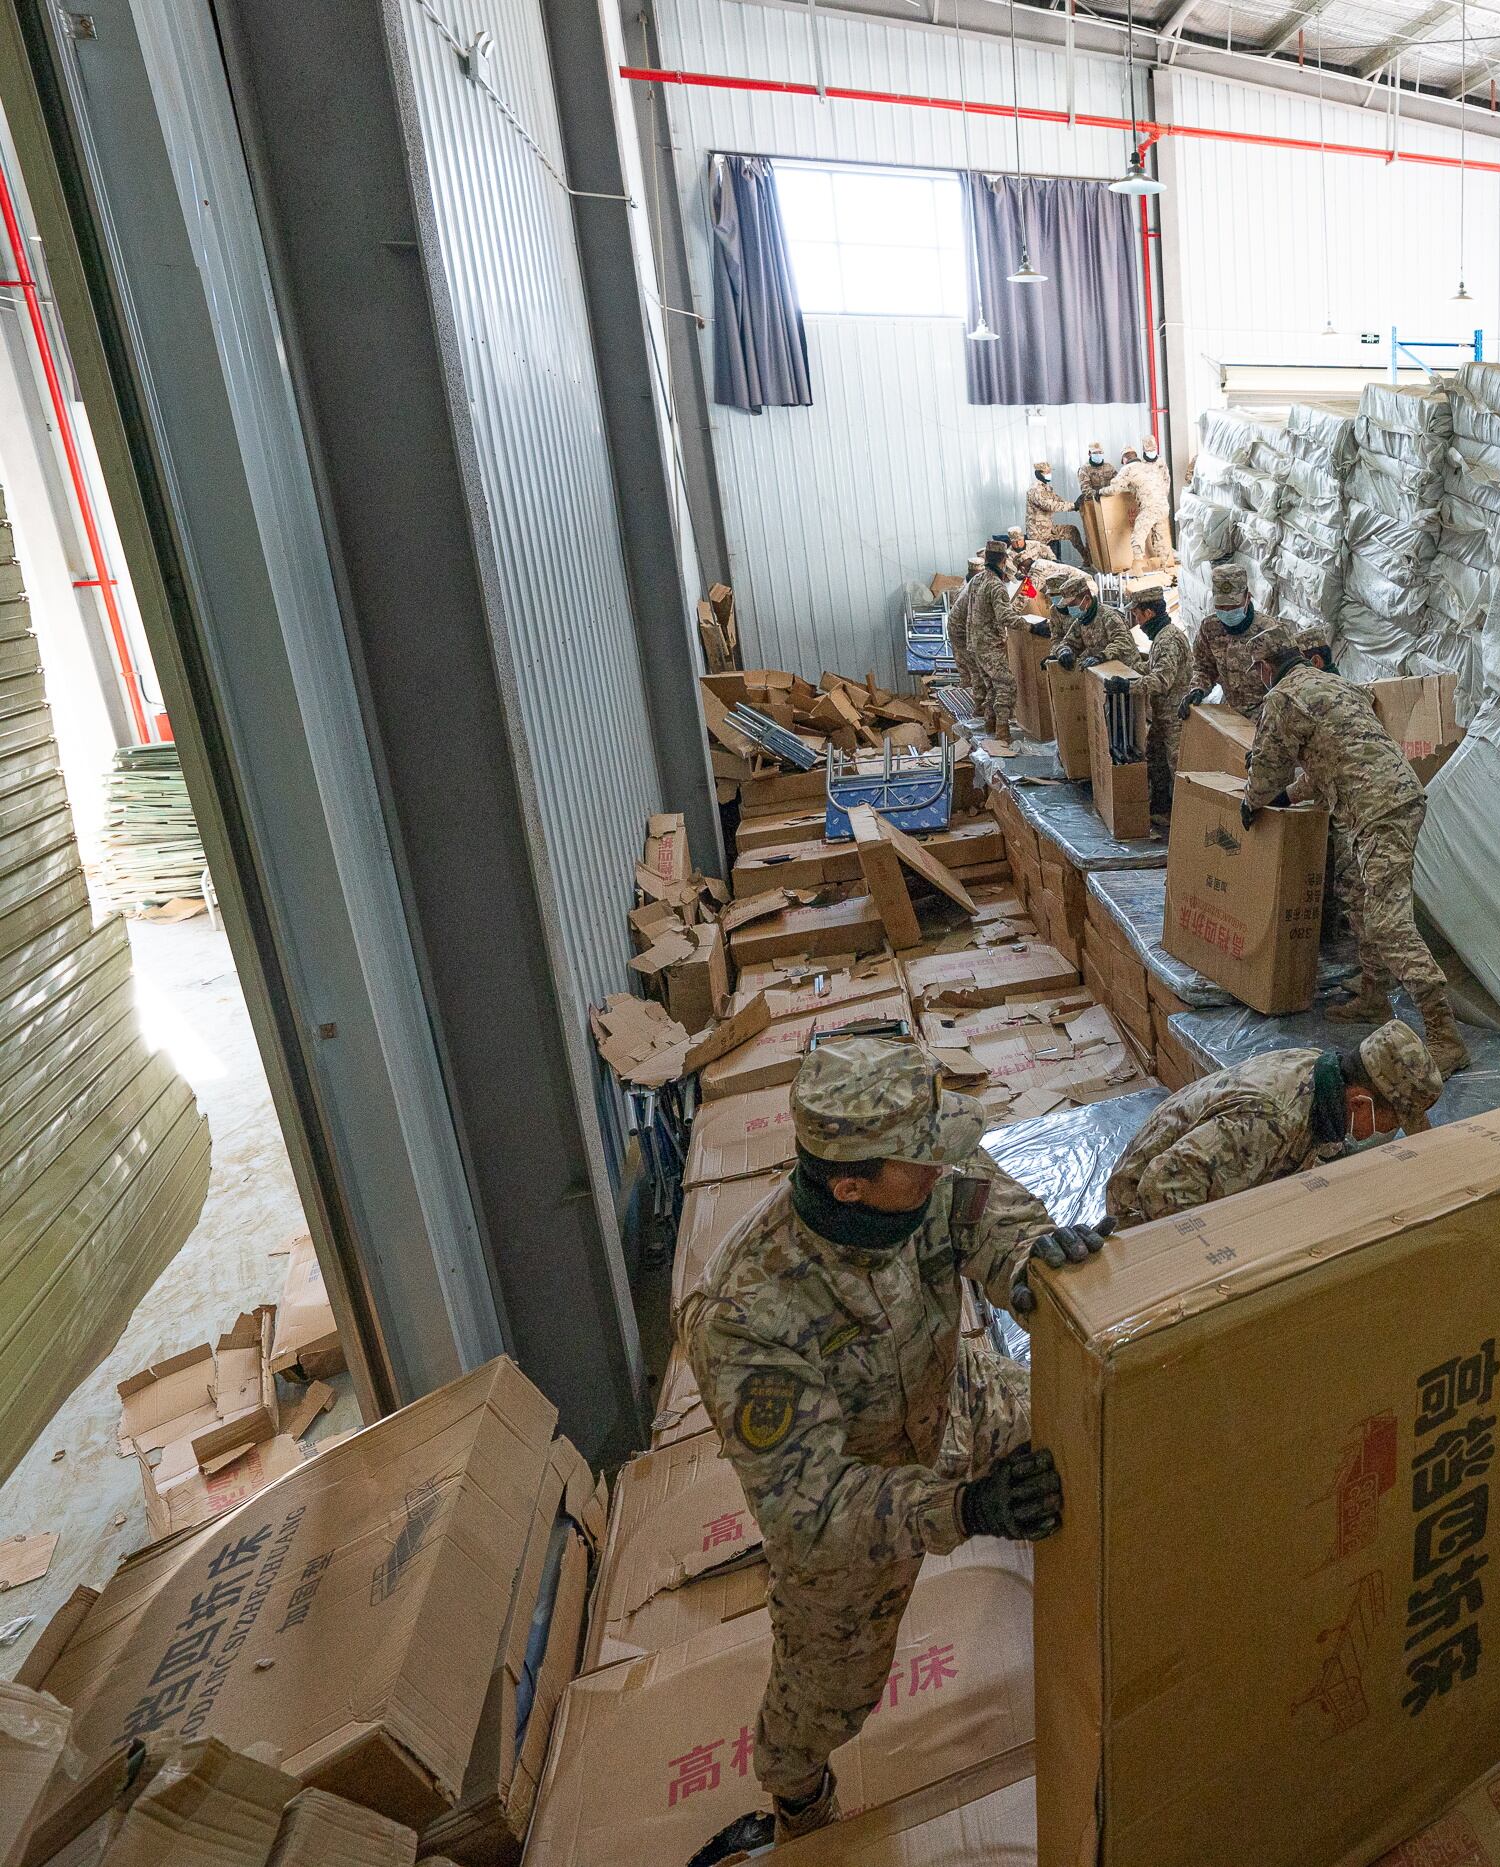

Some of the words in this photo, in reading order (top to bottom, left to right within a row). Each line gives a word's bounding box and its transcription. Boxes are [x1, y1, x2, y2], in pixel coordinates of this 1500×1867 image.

[1179, 906, 1245, 961] 高档四折床
[1402, 1338, 1500, 1717] 高档四折床
[275, 1549, 336, 1635] 加固型
